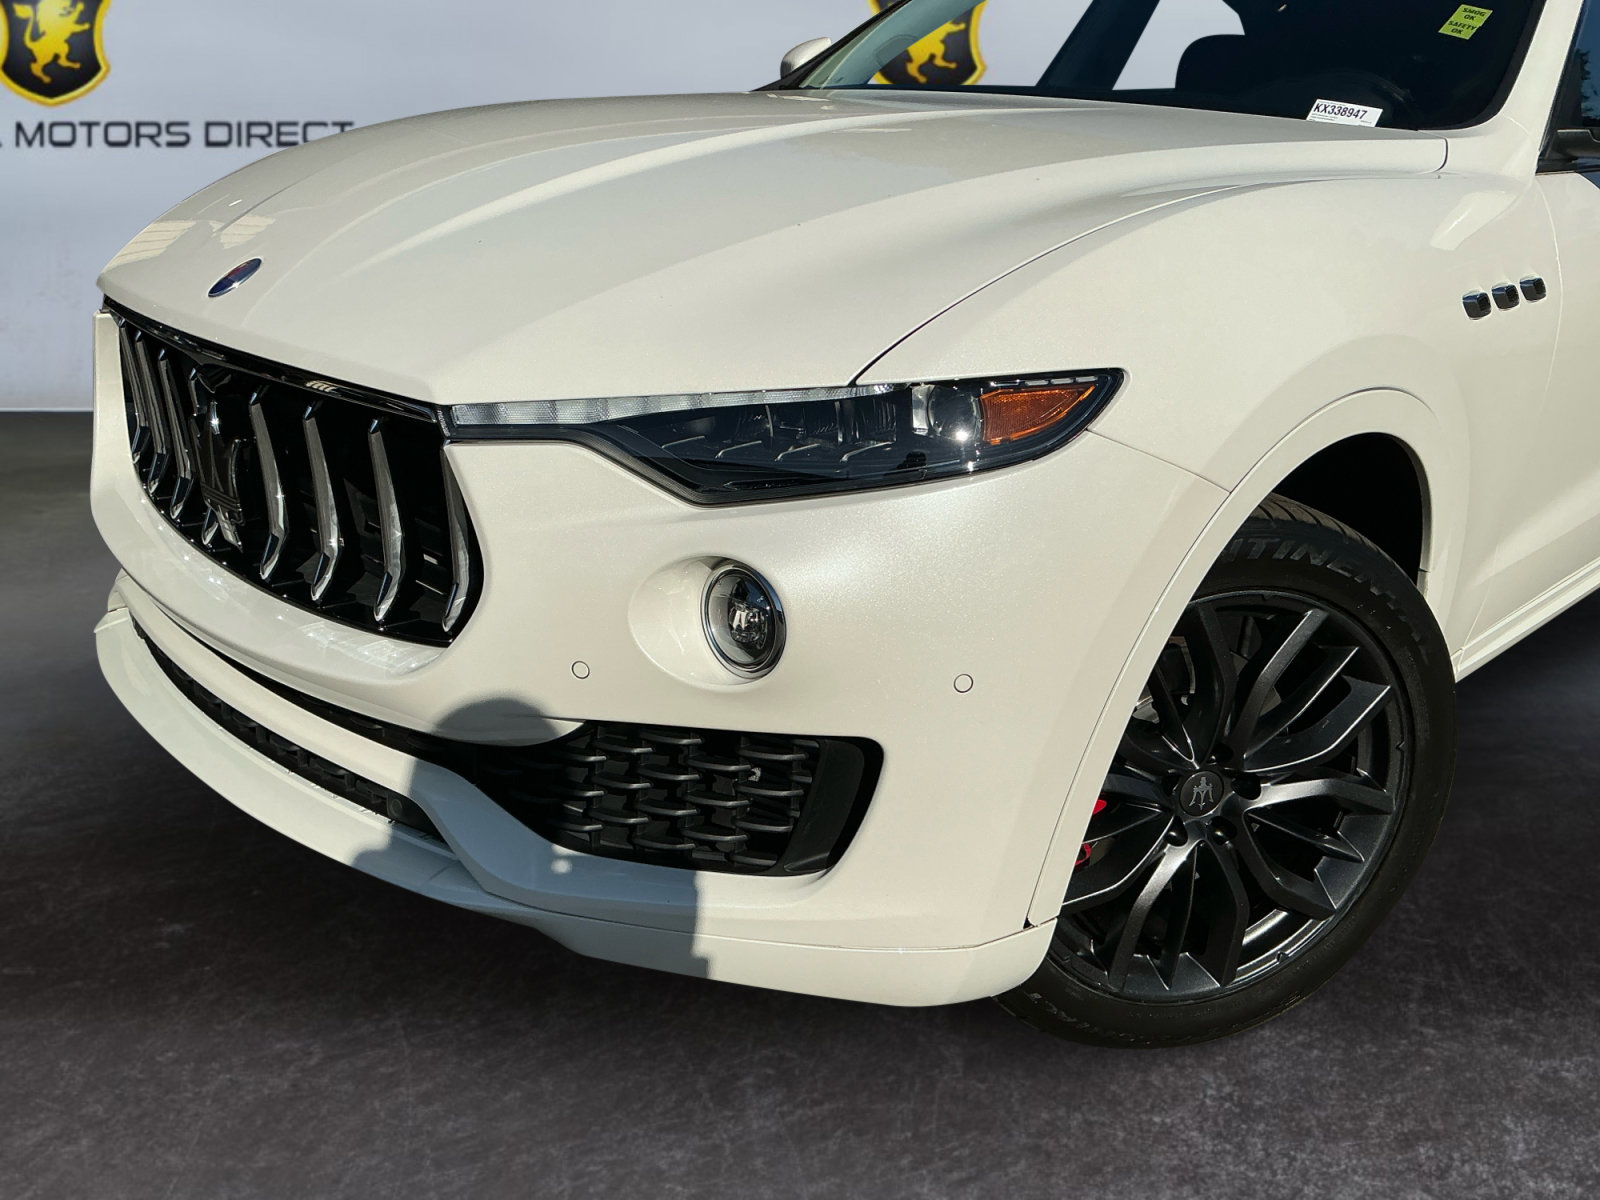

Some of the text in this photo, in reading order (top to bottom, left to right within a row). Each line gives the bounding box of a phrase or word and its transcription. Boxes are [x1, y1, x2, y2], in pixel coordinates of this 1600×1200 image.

[1462, 8, 1486, 17] SMOG
[1448, 20, 1477, 30] SAFETY
[1313, 103, 1368, 119] KX338947
[15, 120, 191, 148] MOTORS
